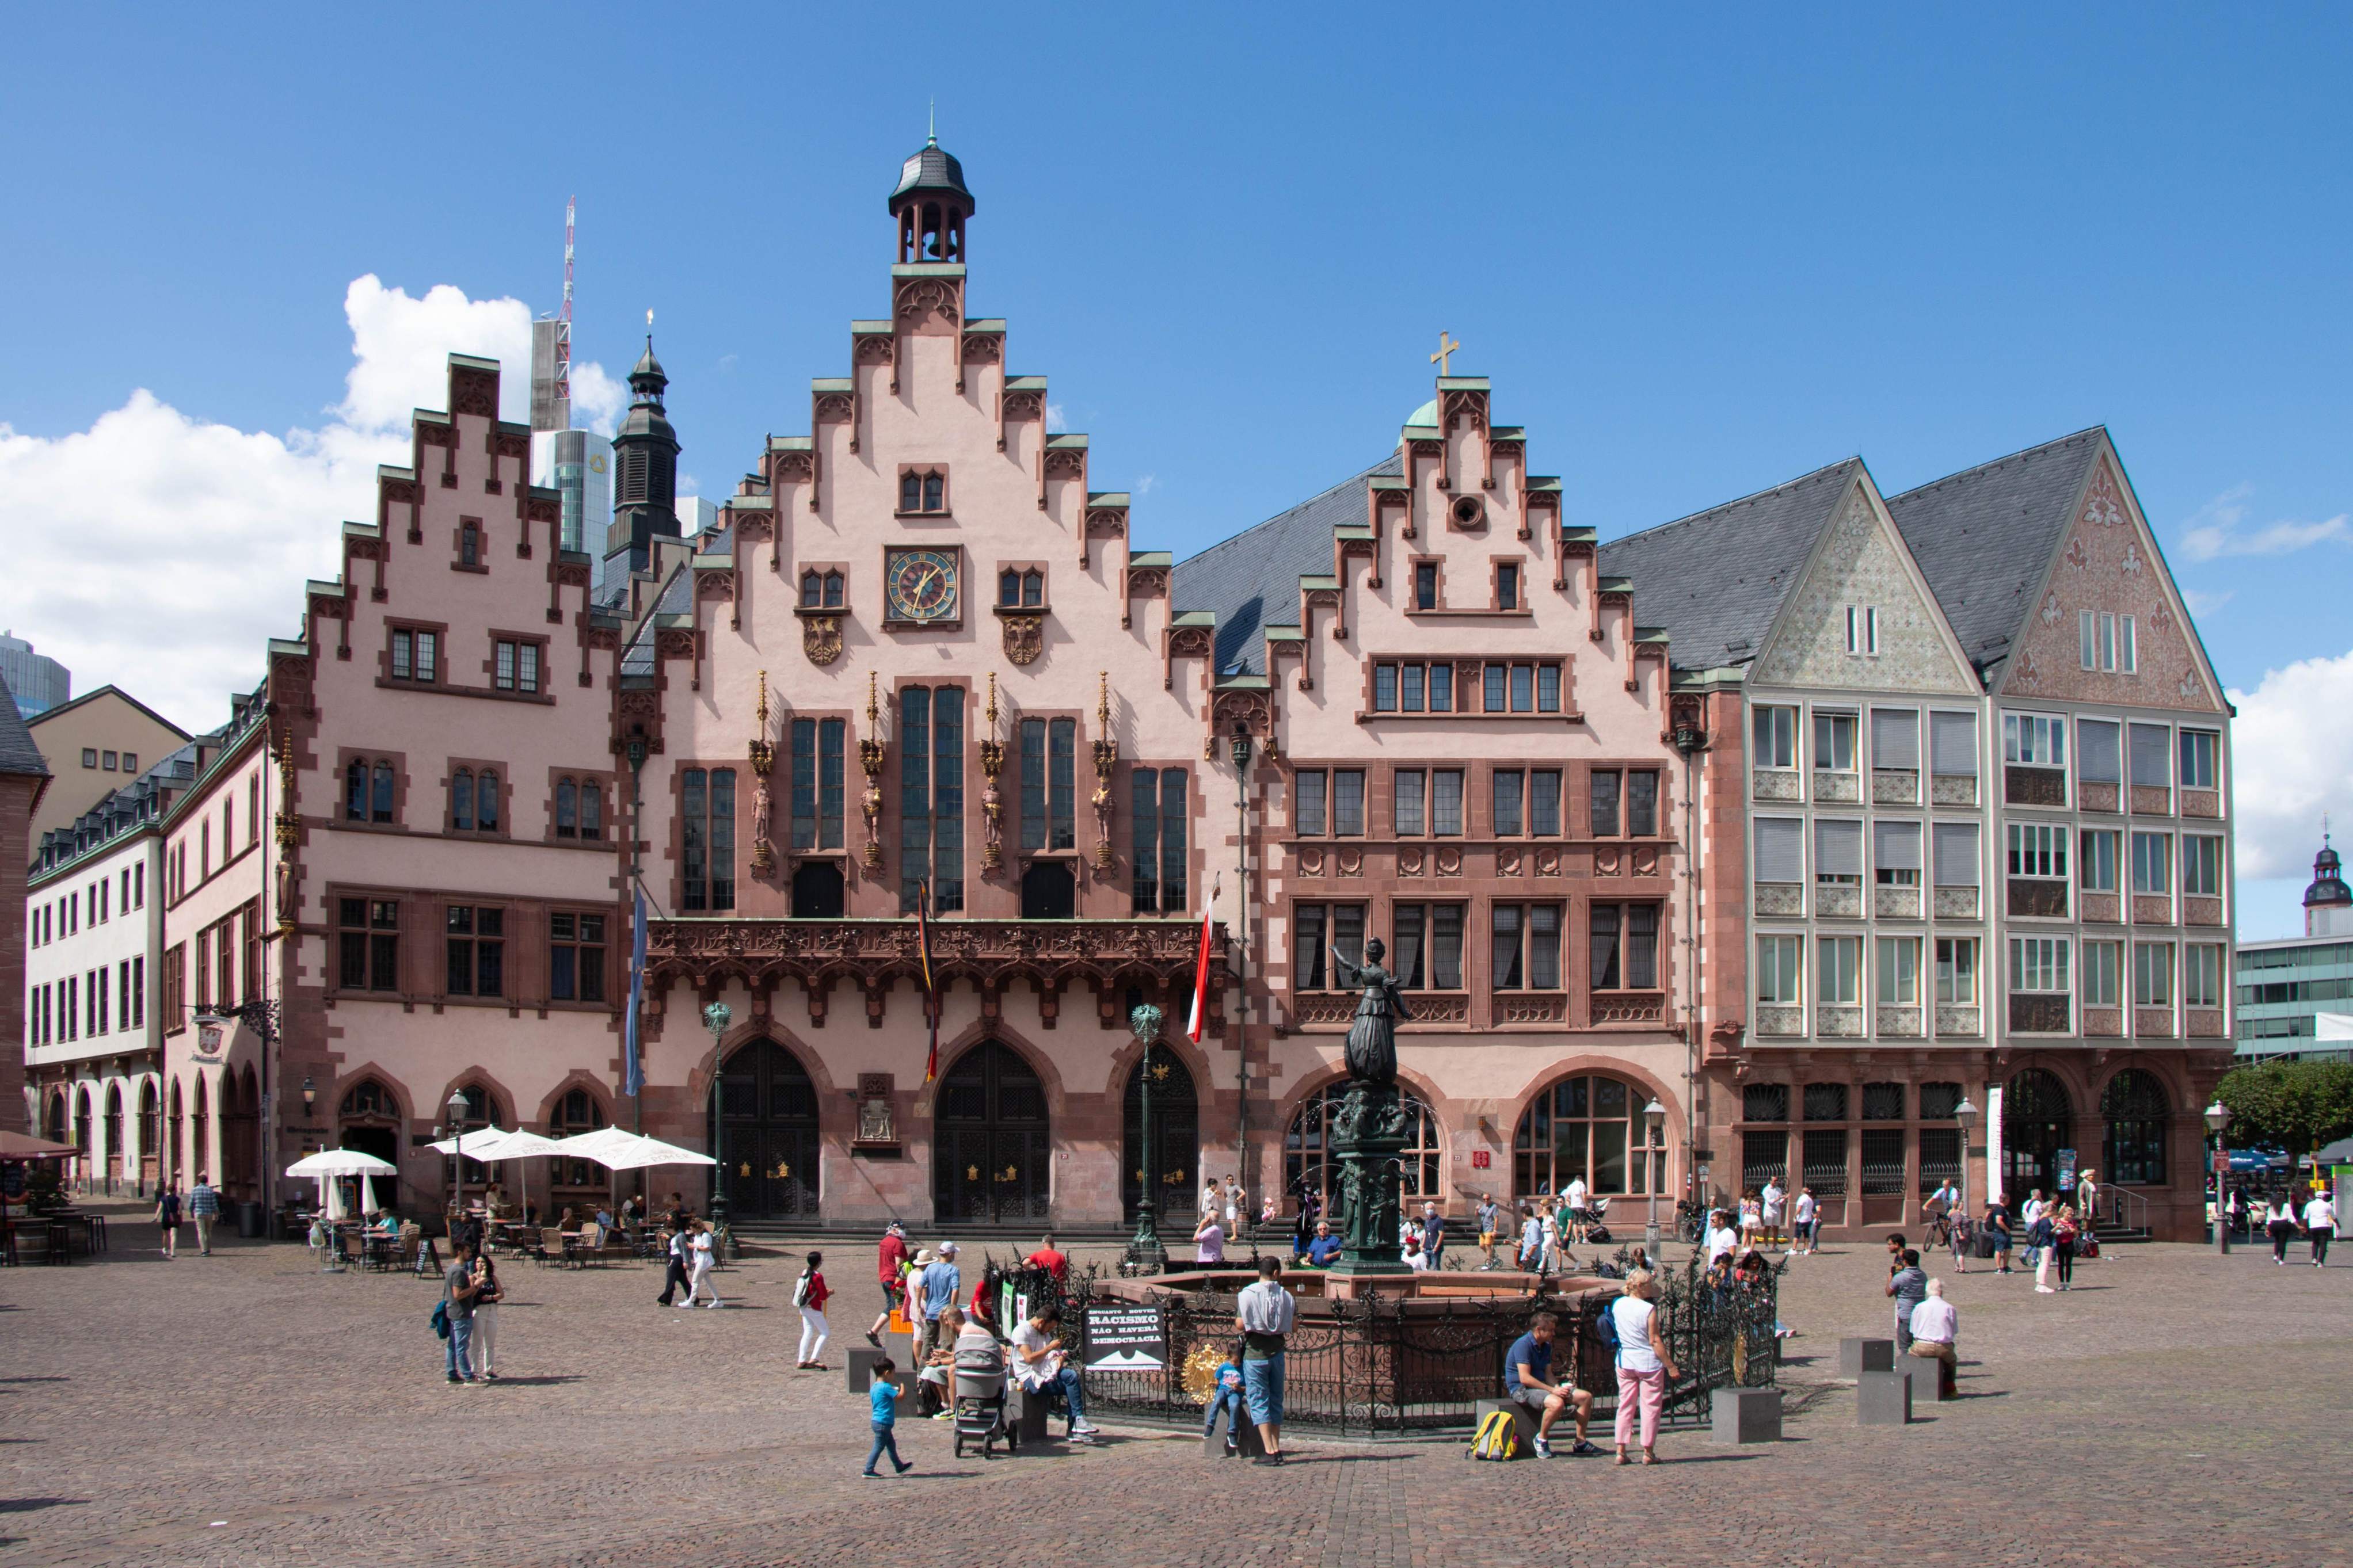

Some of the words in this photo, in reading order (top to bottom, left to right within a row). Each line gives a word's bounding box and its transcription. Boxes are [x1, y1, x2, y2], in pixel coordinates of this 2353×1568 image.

[904, 556, 912, 564] XI
[918, 553, 926, 561] XII
[1089, 1315, 1159, 1325] RACISMO
[1118, 1325, 1159, 1333] HAVERÁ
[1092, 1336, 1162, 1344] DEMOCRACIA
